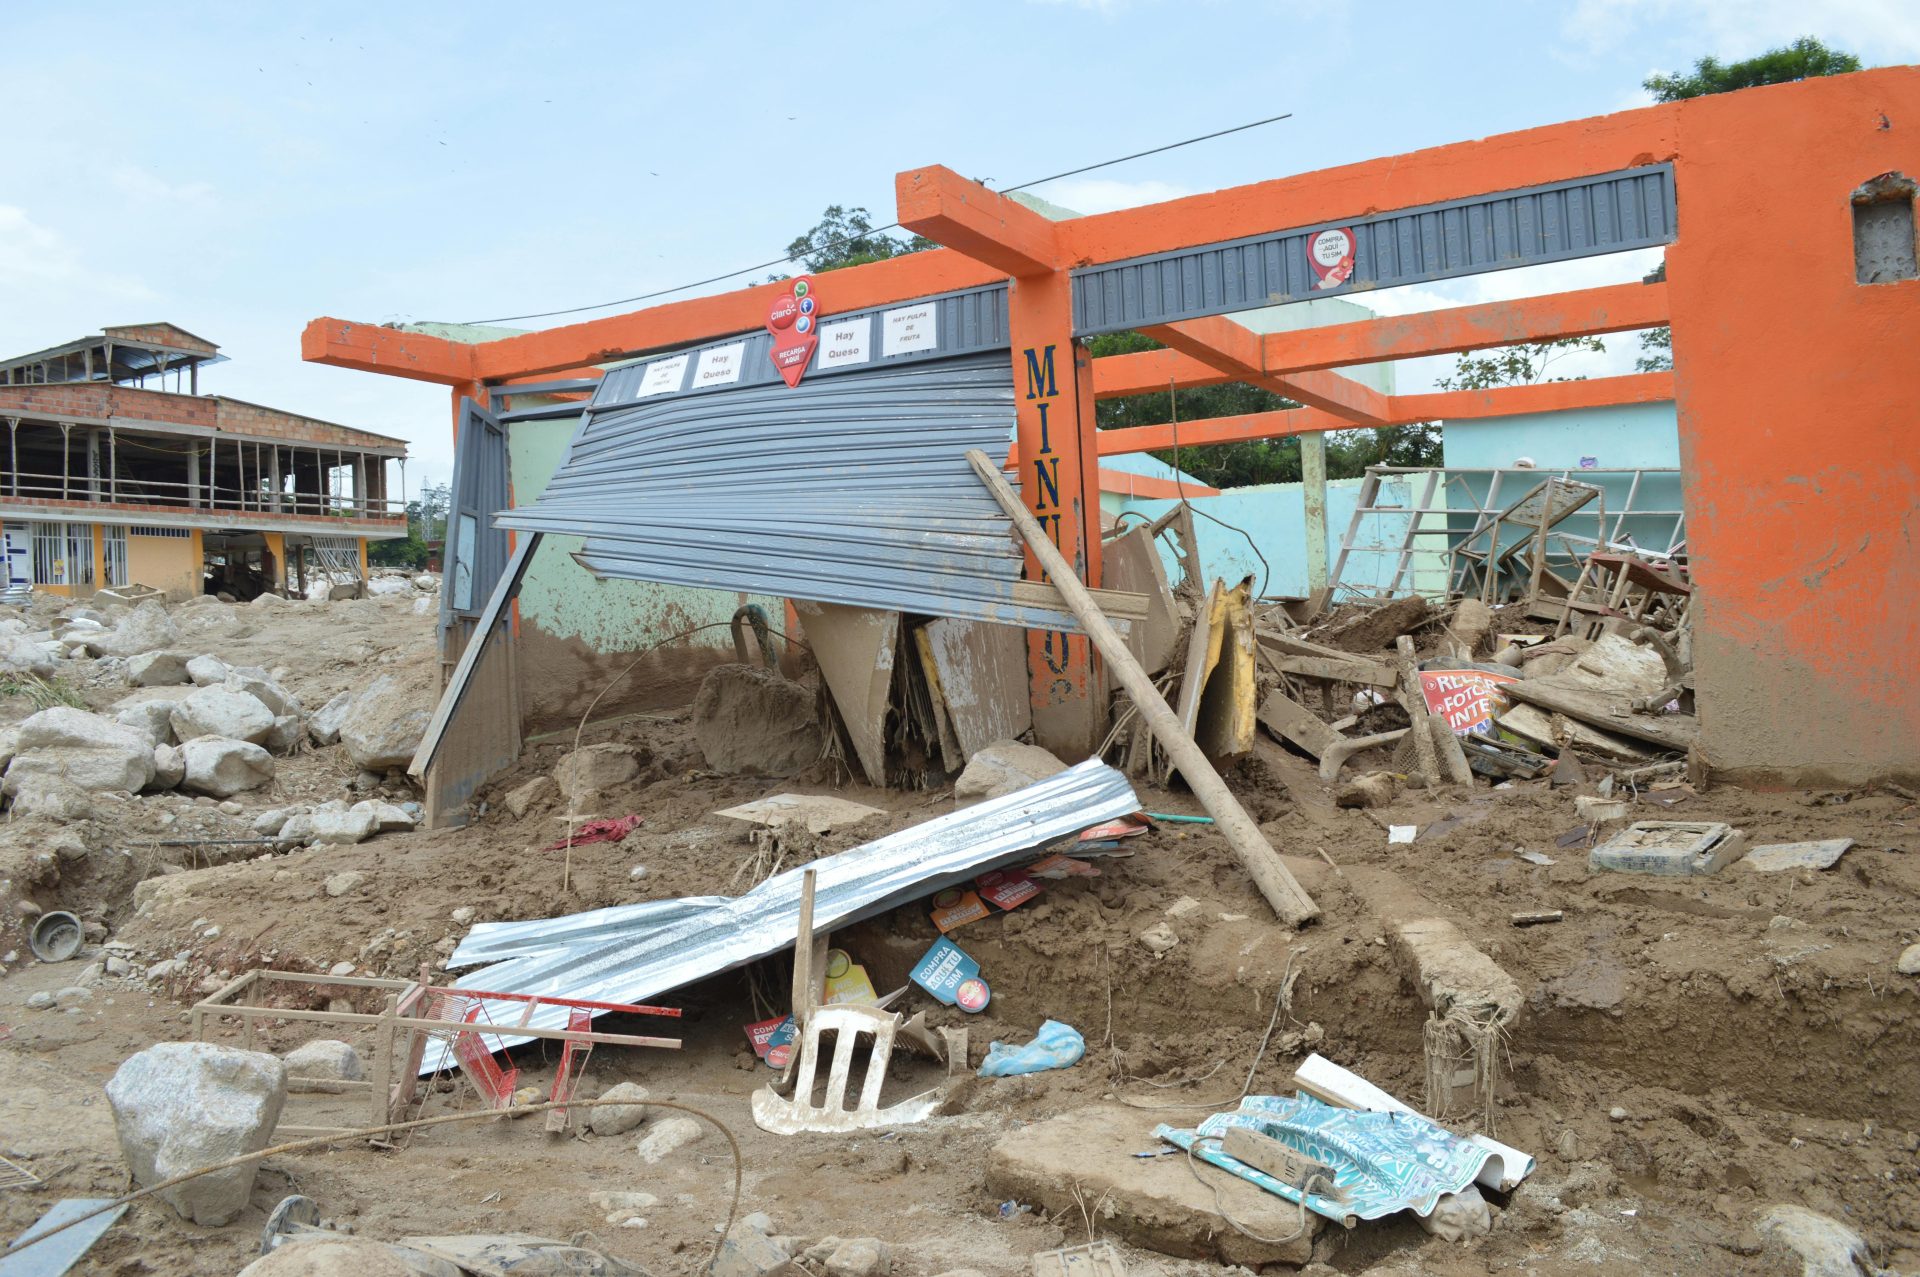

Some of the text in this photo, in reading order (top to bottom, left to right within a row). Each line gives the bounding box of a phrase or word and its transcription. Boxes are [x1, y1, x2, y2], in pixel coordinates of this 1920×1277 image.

[1318, 235, 1343, 245] COMPRA
[1330, 250, 1342, 258] SIM
[771, 305, 794, 321] Claro
[835, 331, 855, 342] Hay
[899, 334, 920, 342] FRUTA
[779, 346, 806, 358] RECARGA
[828, 347, 859, 358] Queso
[712, 355, 728, 364] Hay
[703, 369, 731, 379] Queso
[919, 945, 951, 981] COMPRA
[946, 953, 960, 967] TU
[944, 968, 964, 989] SIM
[753, 1022, 782, 1035] COMP
